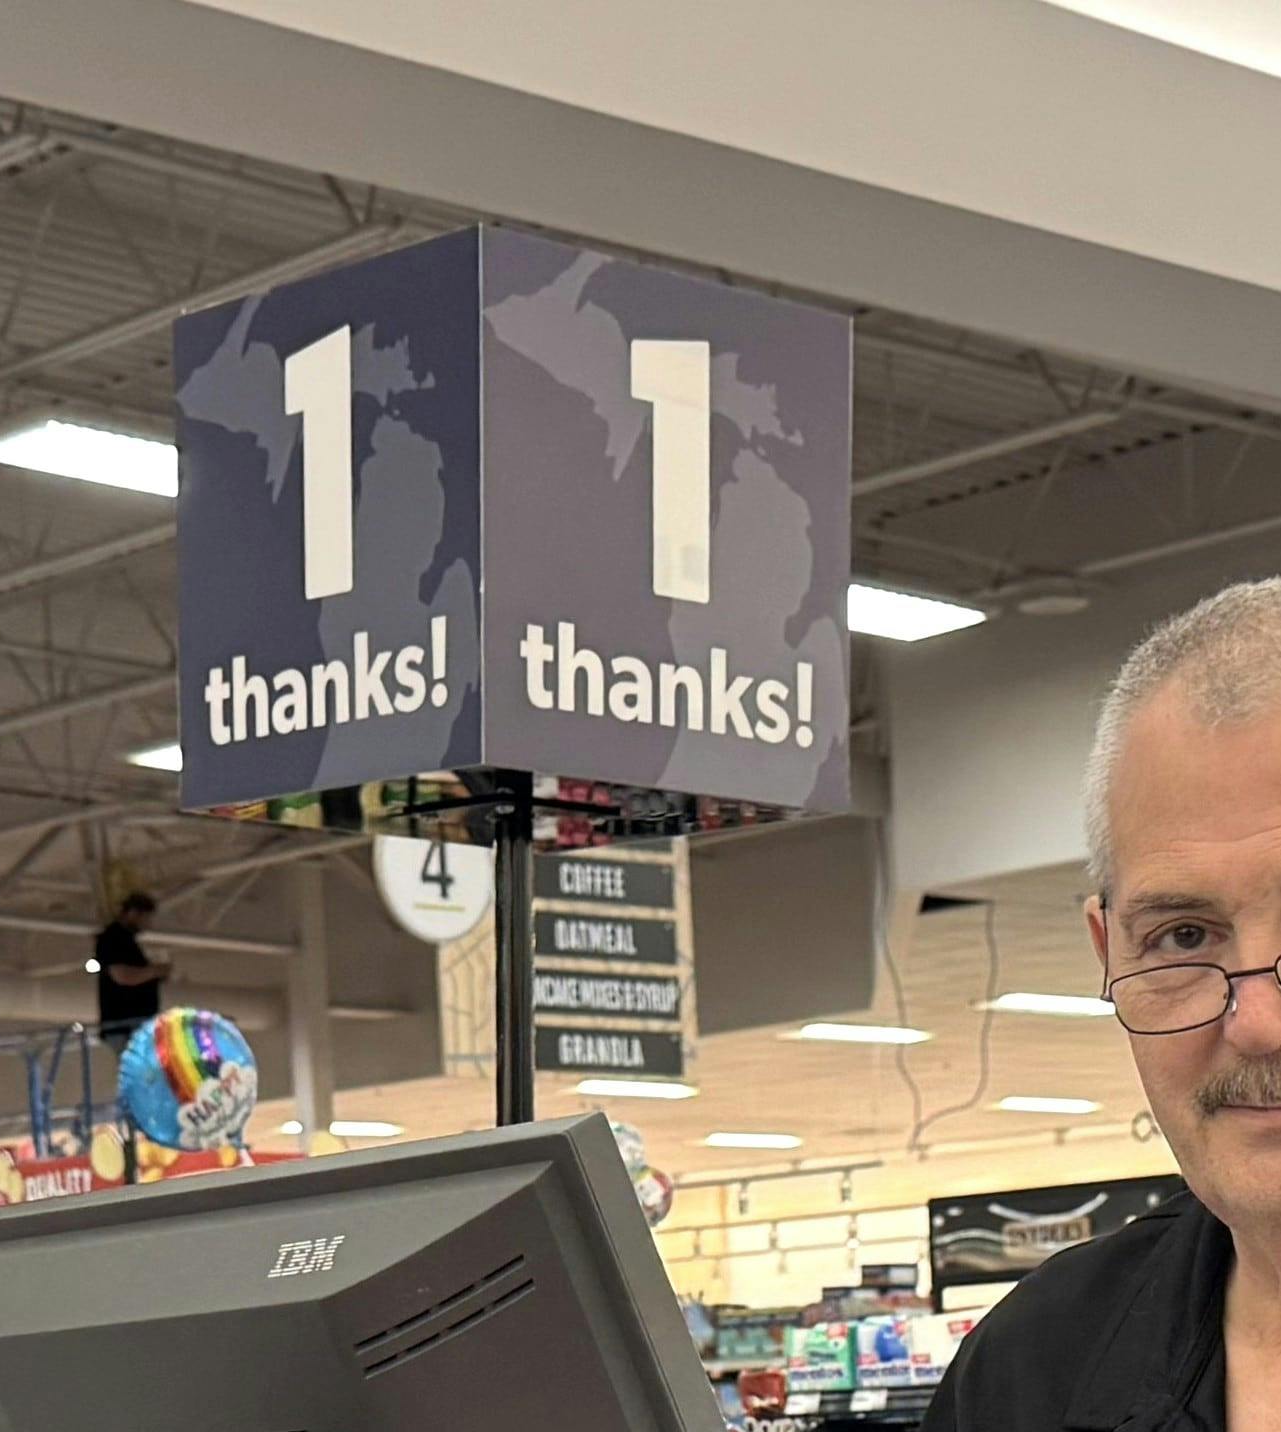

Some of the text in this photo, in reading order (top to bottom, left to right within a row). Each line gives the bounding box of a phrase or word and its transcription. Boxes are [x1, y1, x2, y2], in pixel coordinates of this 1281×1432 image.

[284, 323, 354, 600] 1
[630, 339, 711, 604] 1
[204, 615, 449, 747] thanks!
[519, 620, 815, 748] thanks!
[420, 838, 454, 899] 4
[558, 862, 626, 898] COFFEE
[554, 919, 638, 956] OATMEAL
[558, 1033, 645, 1068] GRANOLA
[186, 1069, 245, 1127] HAPPY
[24, 1169, 92, 1201] QUALITY
[268, 1234, 345, 1279] IBM
